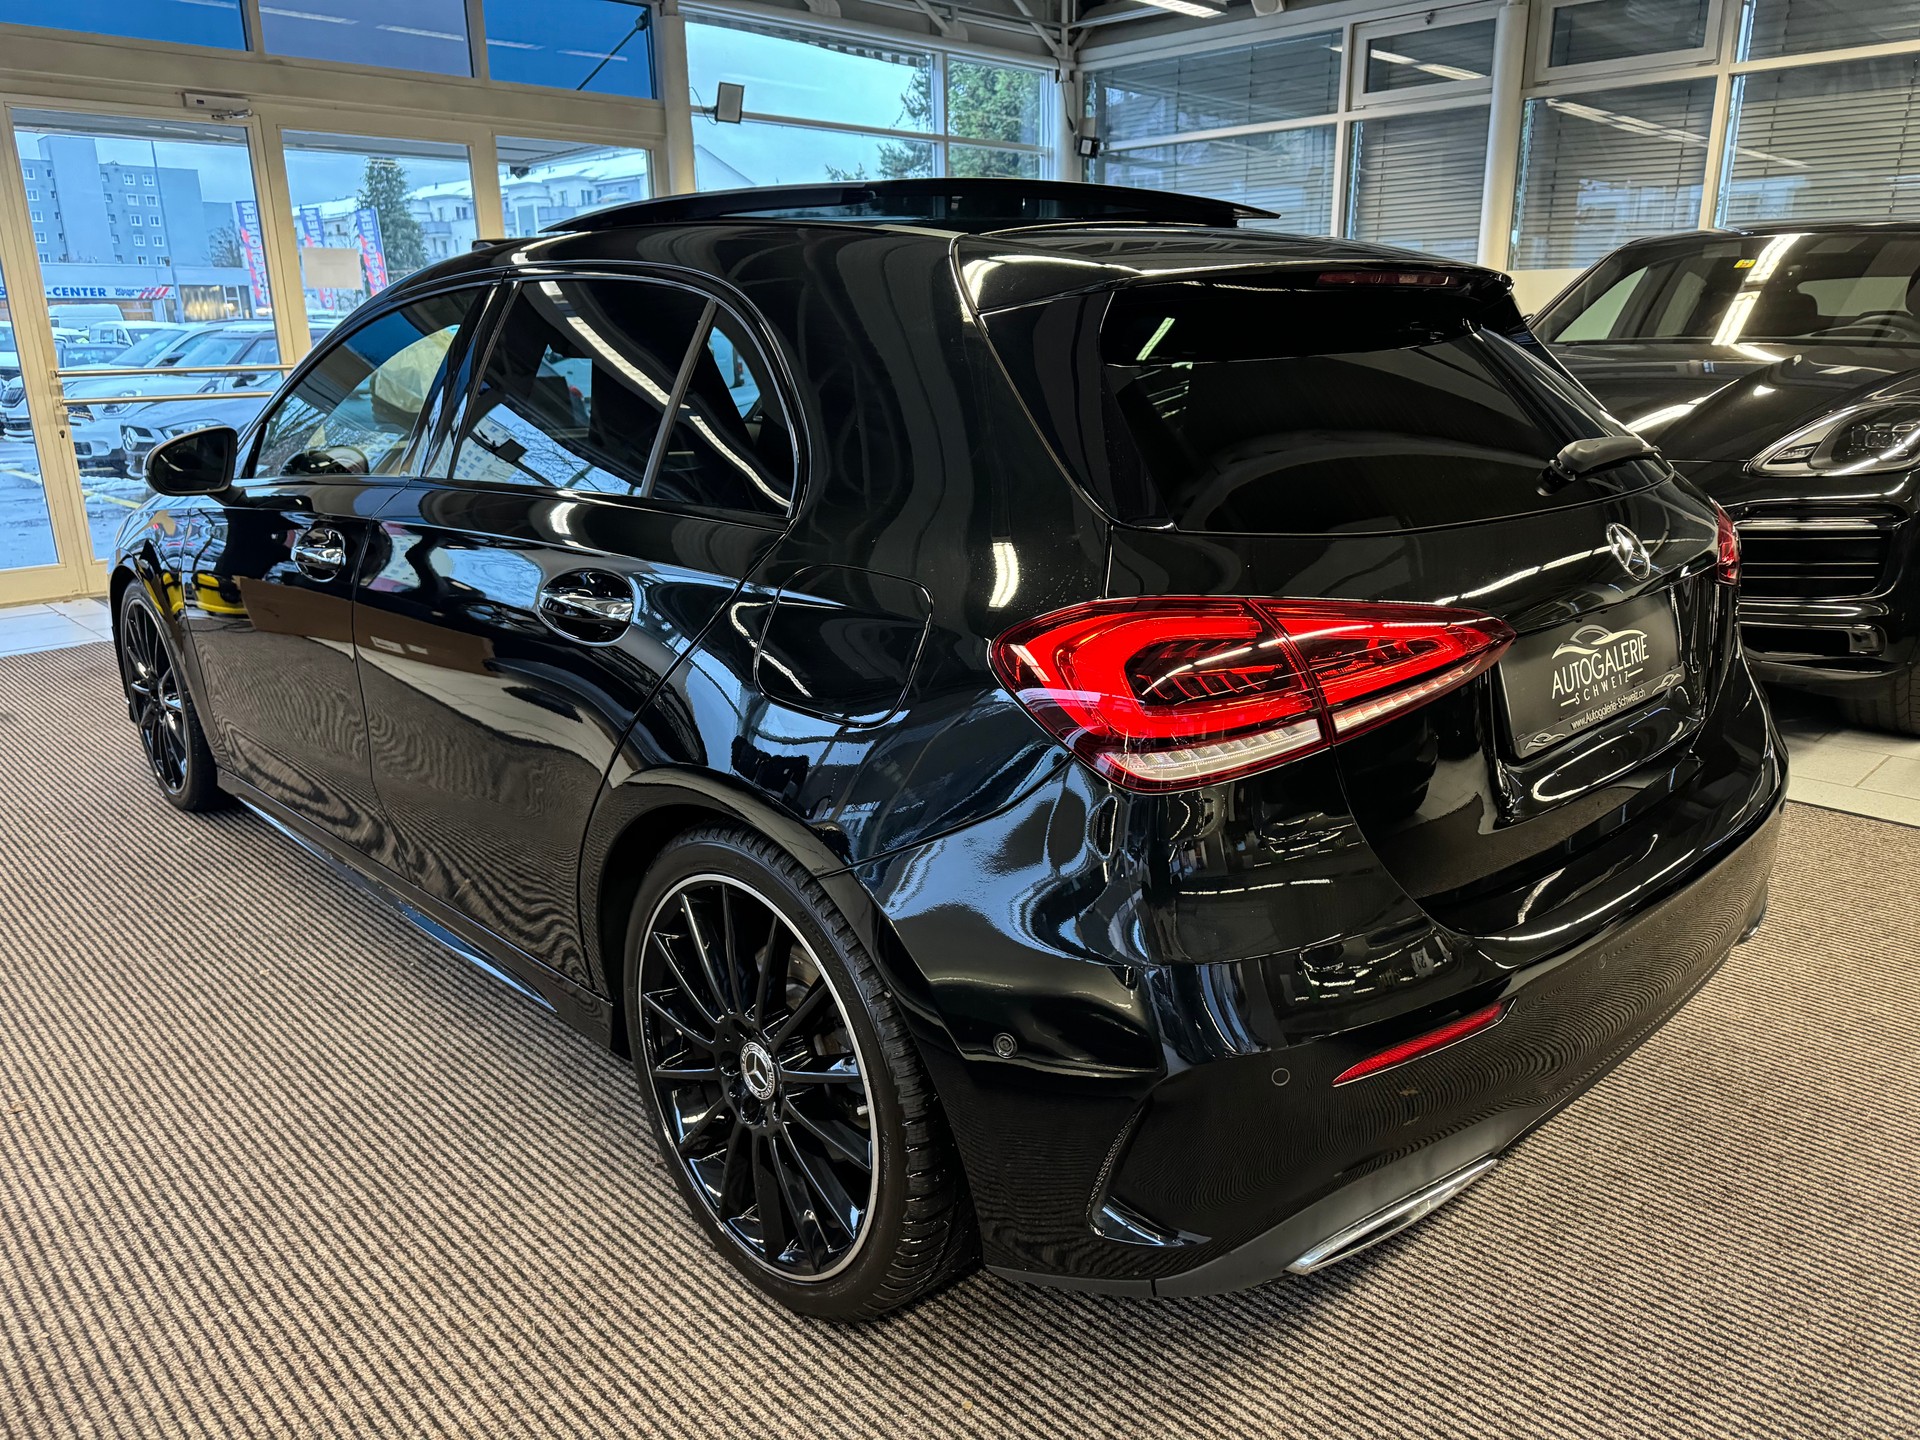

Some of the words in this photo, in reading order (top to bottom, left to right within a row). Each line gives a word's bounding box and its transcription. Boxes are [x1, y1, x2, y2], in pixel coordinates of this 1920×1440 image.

[1553, 635, 1650, 699] AUTOGALERIE
[1575, 670, 1629, 705] SCHWEIZ
[1571, 689, 1646, 730] www.Autogalerie-Schweiz.ch
